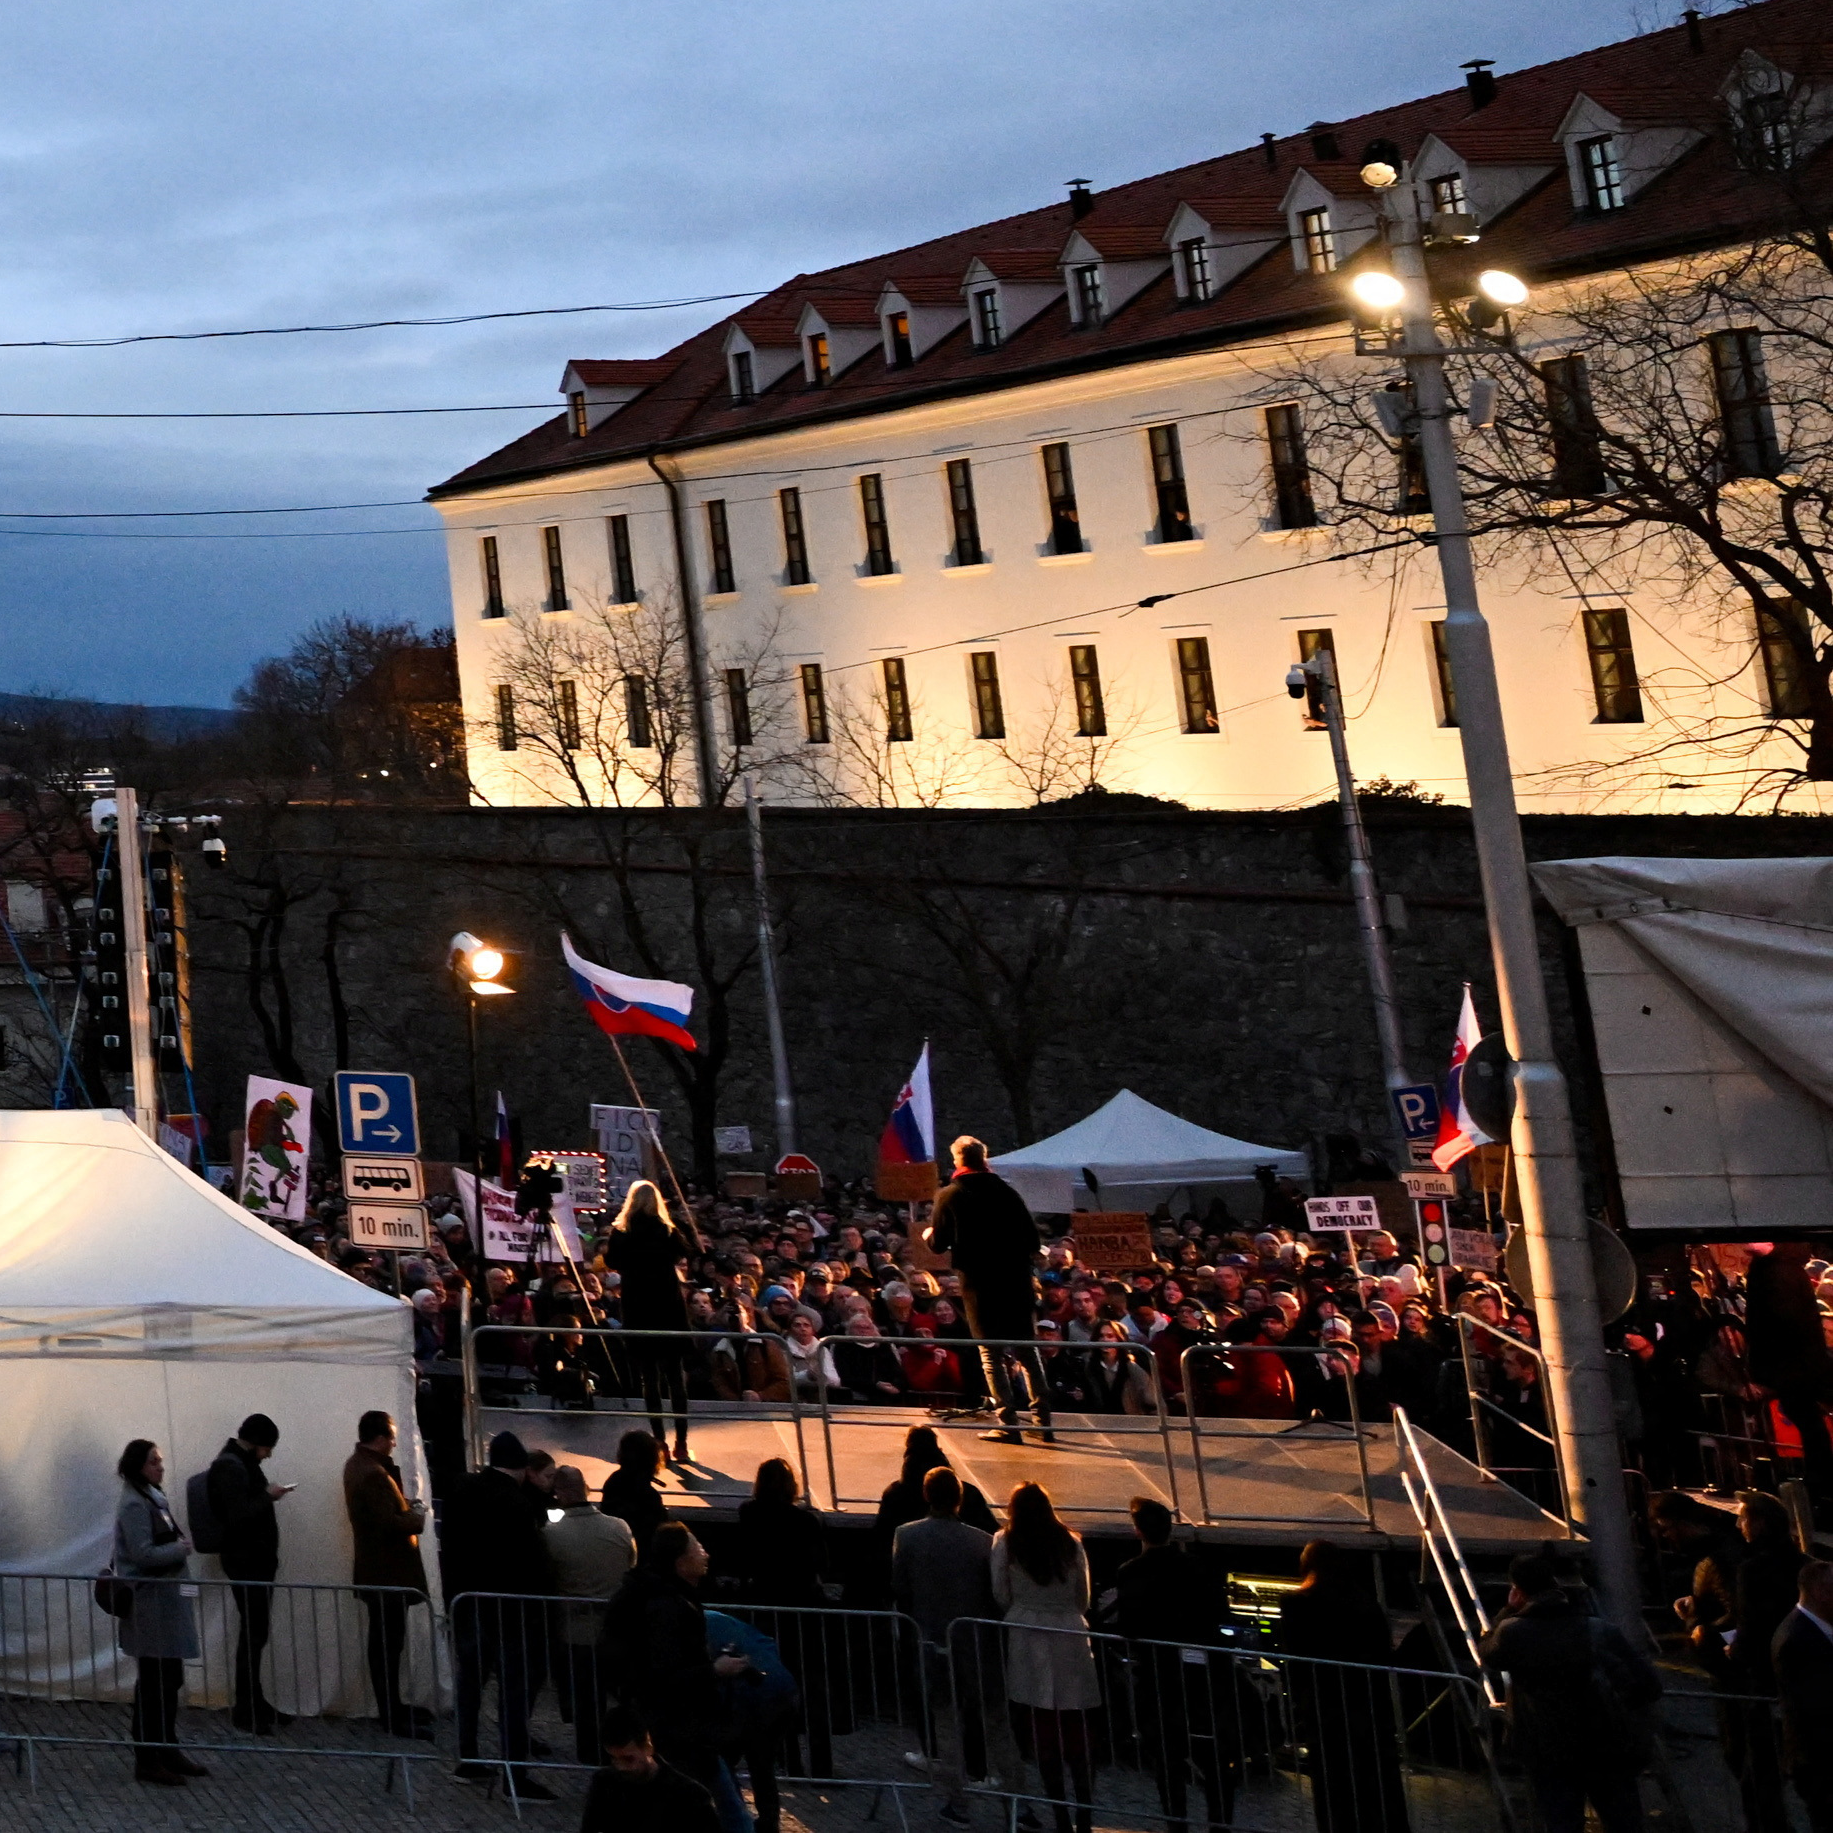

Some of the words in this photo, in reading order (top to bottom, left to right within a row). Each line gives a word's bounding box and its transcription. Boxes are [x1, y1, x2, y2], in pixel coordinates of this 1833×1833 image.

[349, 1083, 390, 1142] P
[595, 1108, 659, 1131] FICO
[1398, 1093, 1426, 1132] P
[1408, 1179, 1420, 1192] 10
[1425, 1179, 1449, 1193] min.
[358, 1217, 375, 1235] 10
[382, 1218, 419, 1238] min.
[1316, 1215, 1373, 1227] DEMOCRACY
